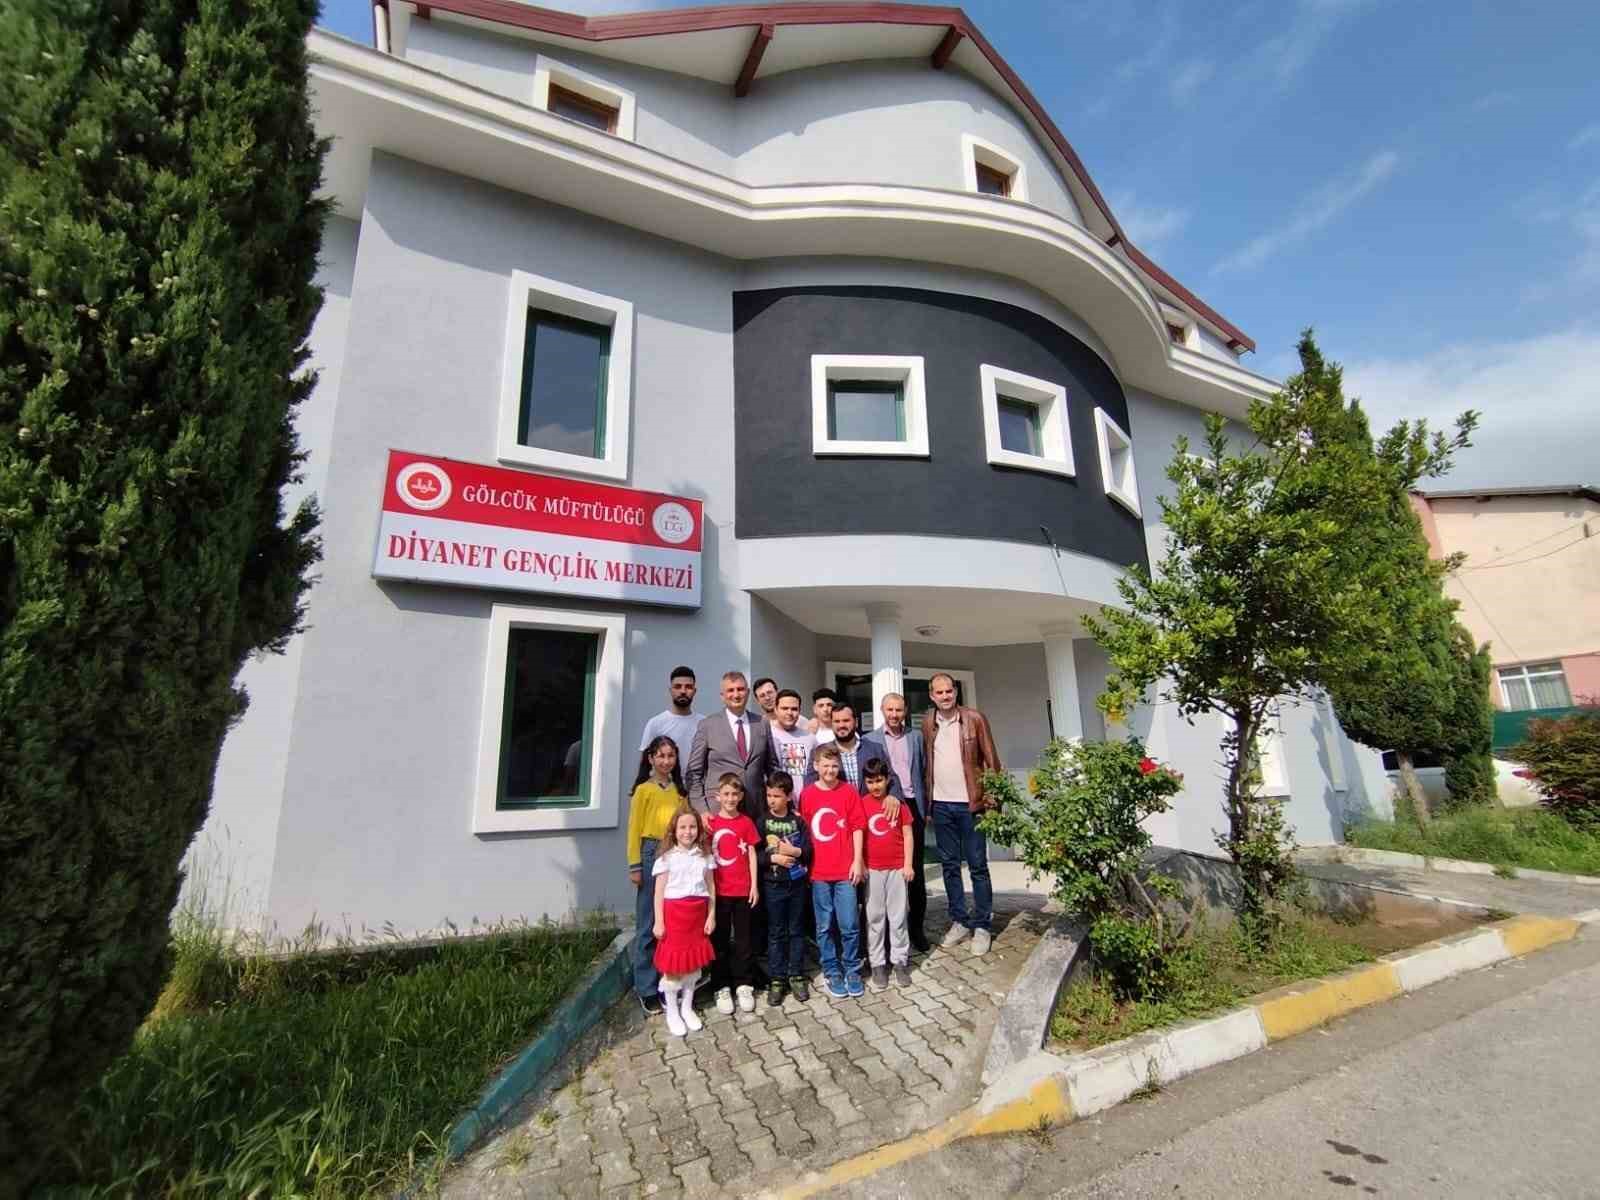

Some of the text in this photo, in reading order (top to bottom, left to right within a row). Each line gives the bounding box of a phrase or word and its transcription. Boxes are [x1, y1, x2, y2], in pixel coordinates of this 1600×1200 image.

[462, 483, 538, 512] GÖLCÜK
[543, 496, 646, 527] MÜFTÜLÜĞÜ
[387, 530, 693, 590] DİYANET GENÇLİK MERKEZİ
